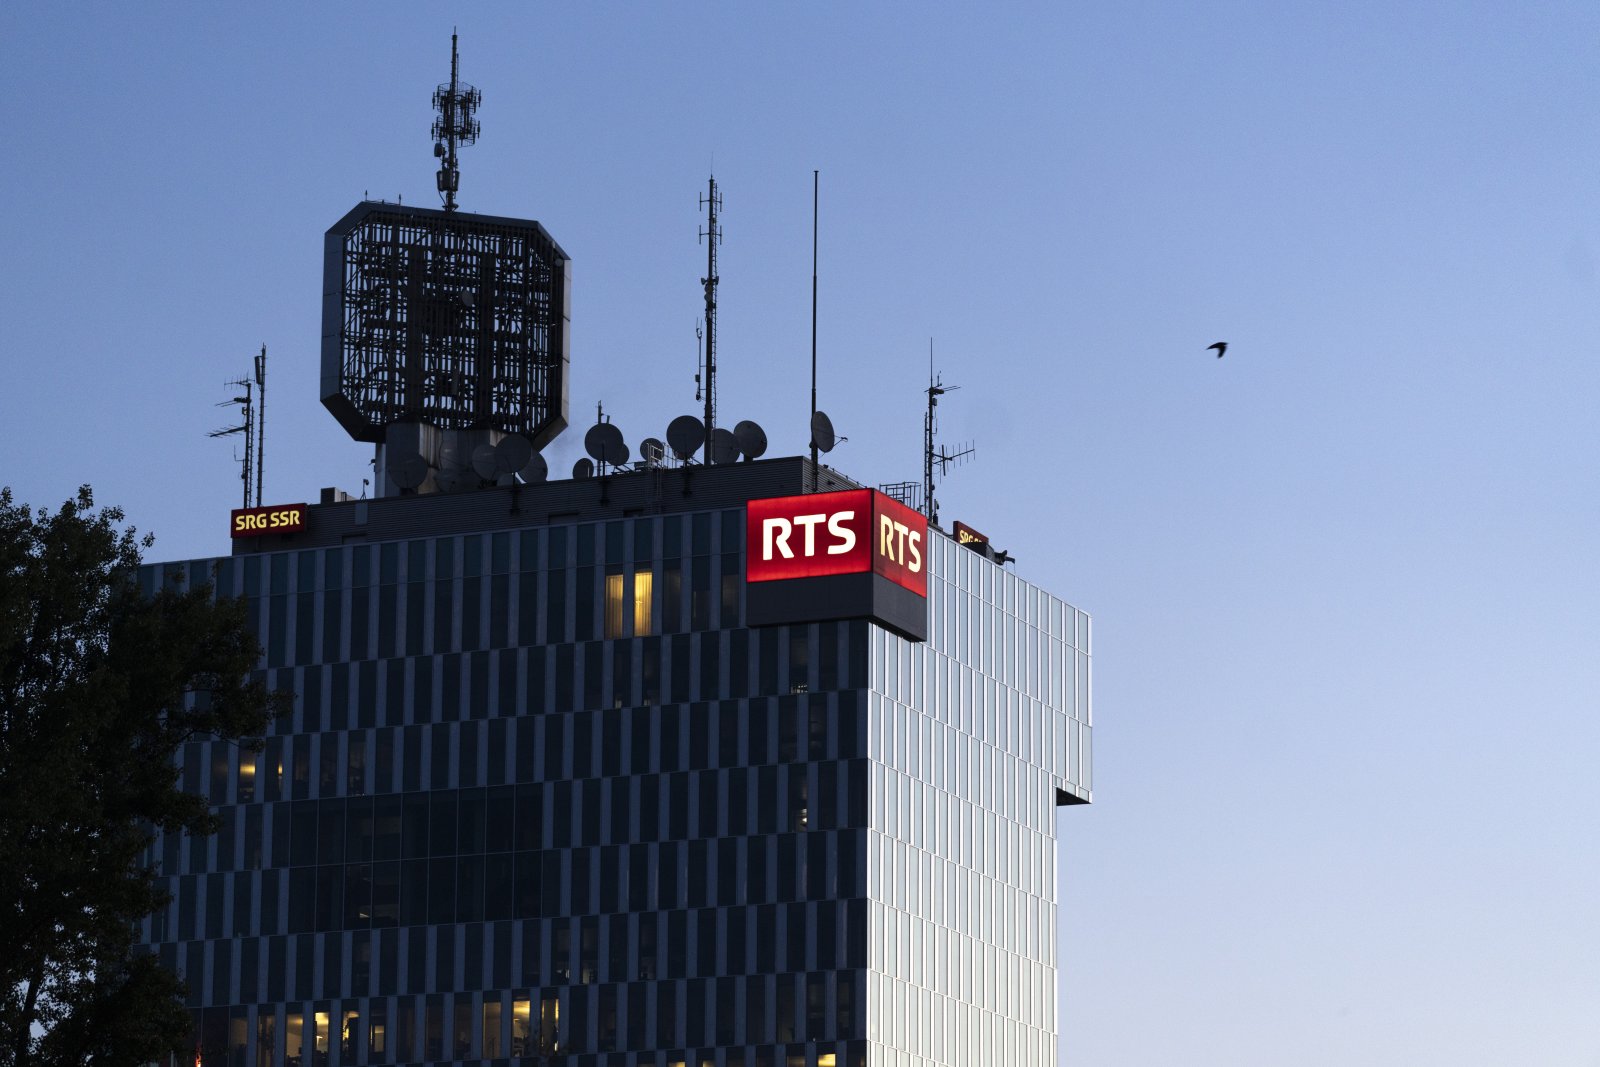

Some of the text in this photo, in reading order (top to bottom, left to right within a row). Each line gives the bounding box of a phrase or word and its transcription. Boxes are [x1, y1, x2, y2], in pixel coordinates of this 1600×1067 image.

[236, 510, 300, 531] SRG SSR
[763, 511, 856, 560] RTS
[880, 513, 921, 573] RTS
